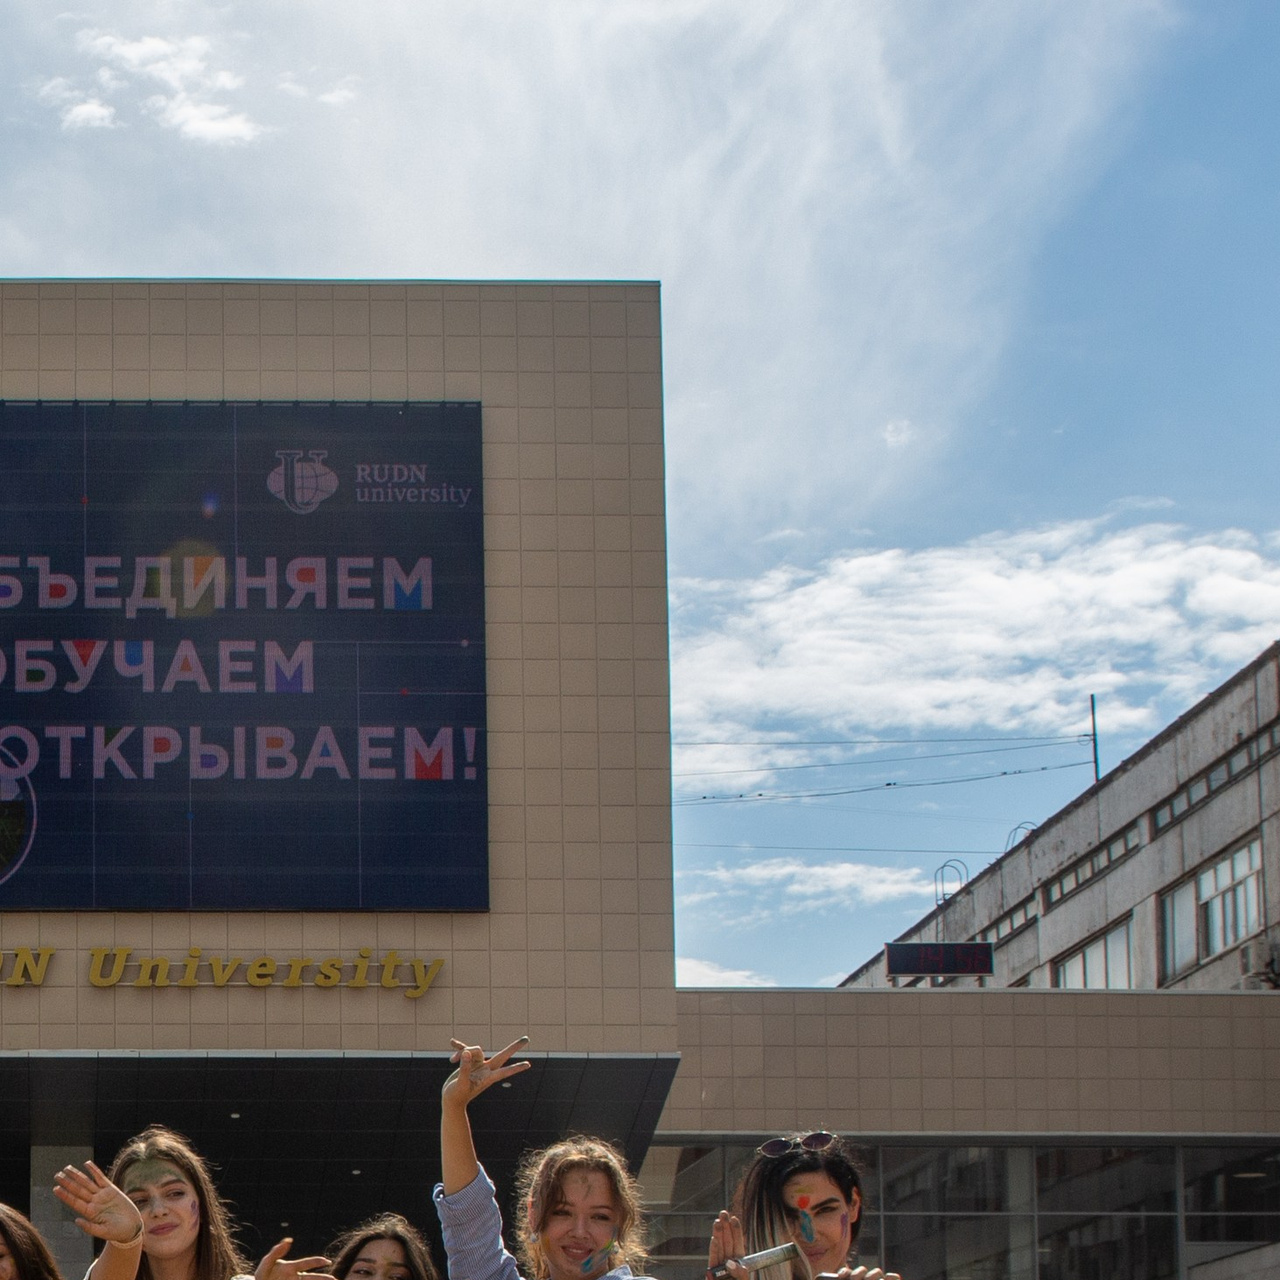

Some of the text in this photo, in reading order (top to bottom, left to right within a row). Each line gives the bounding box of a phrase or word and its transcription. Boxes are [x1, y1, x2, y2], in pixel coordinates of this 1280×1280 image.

[355, 464, 427, 482] RUDN
[355, 483, 472, 508] university
[88, 947, 445, 999] University
